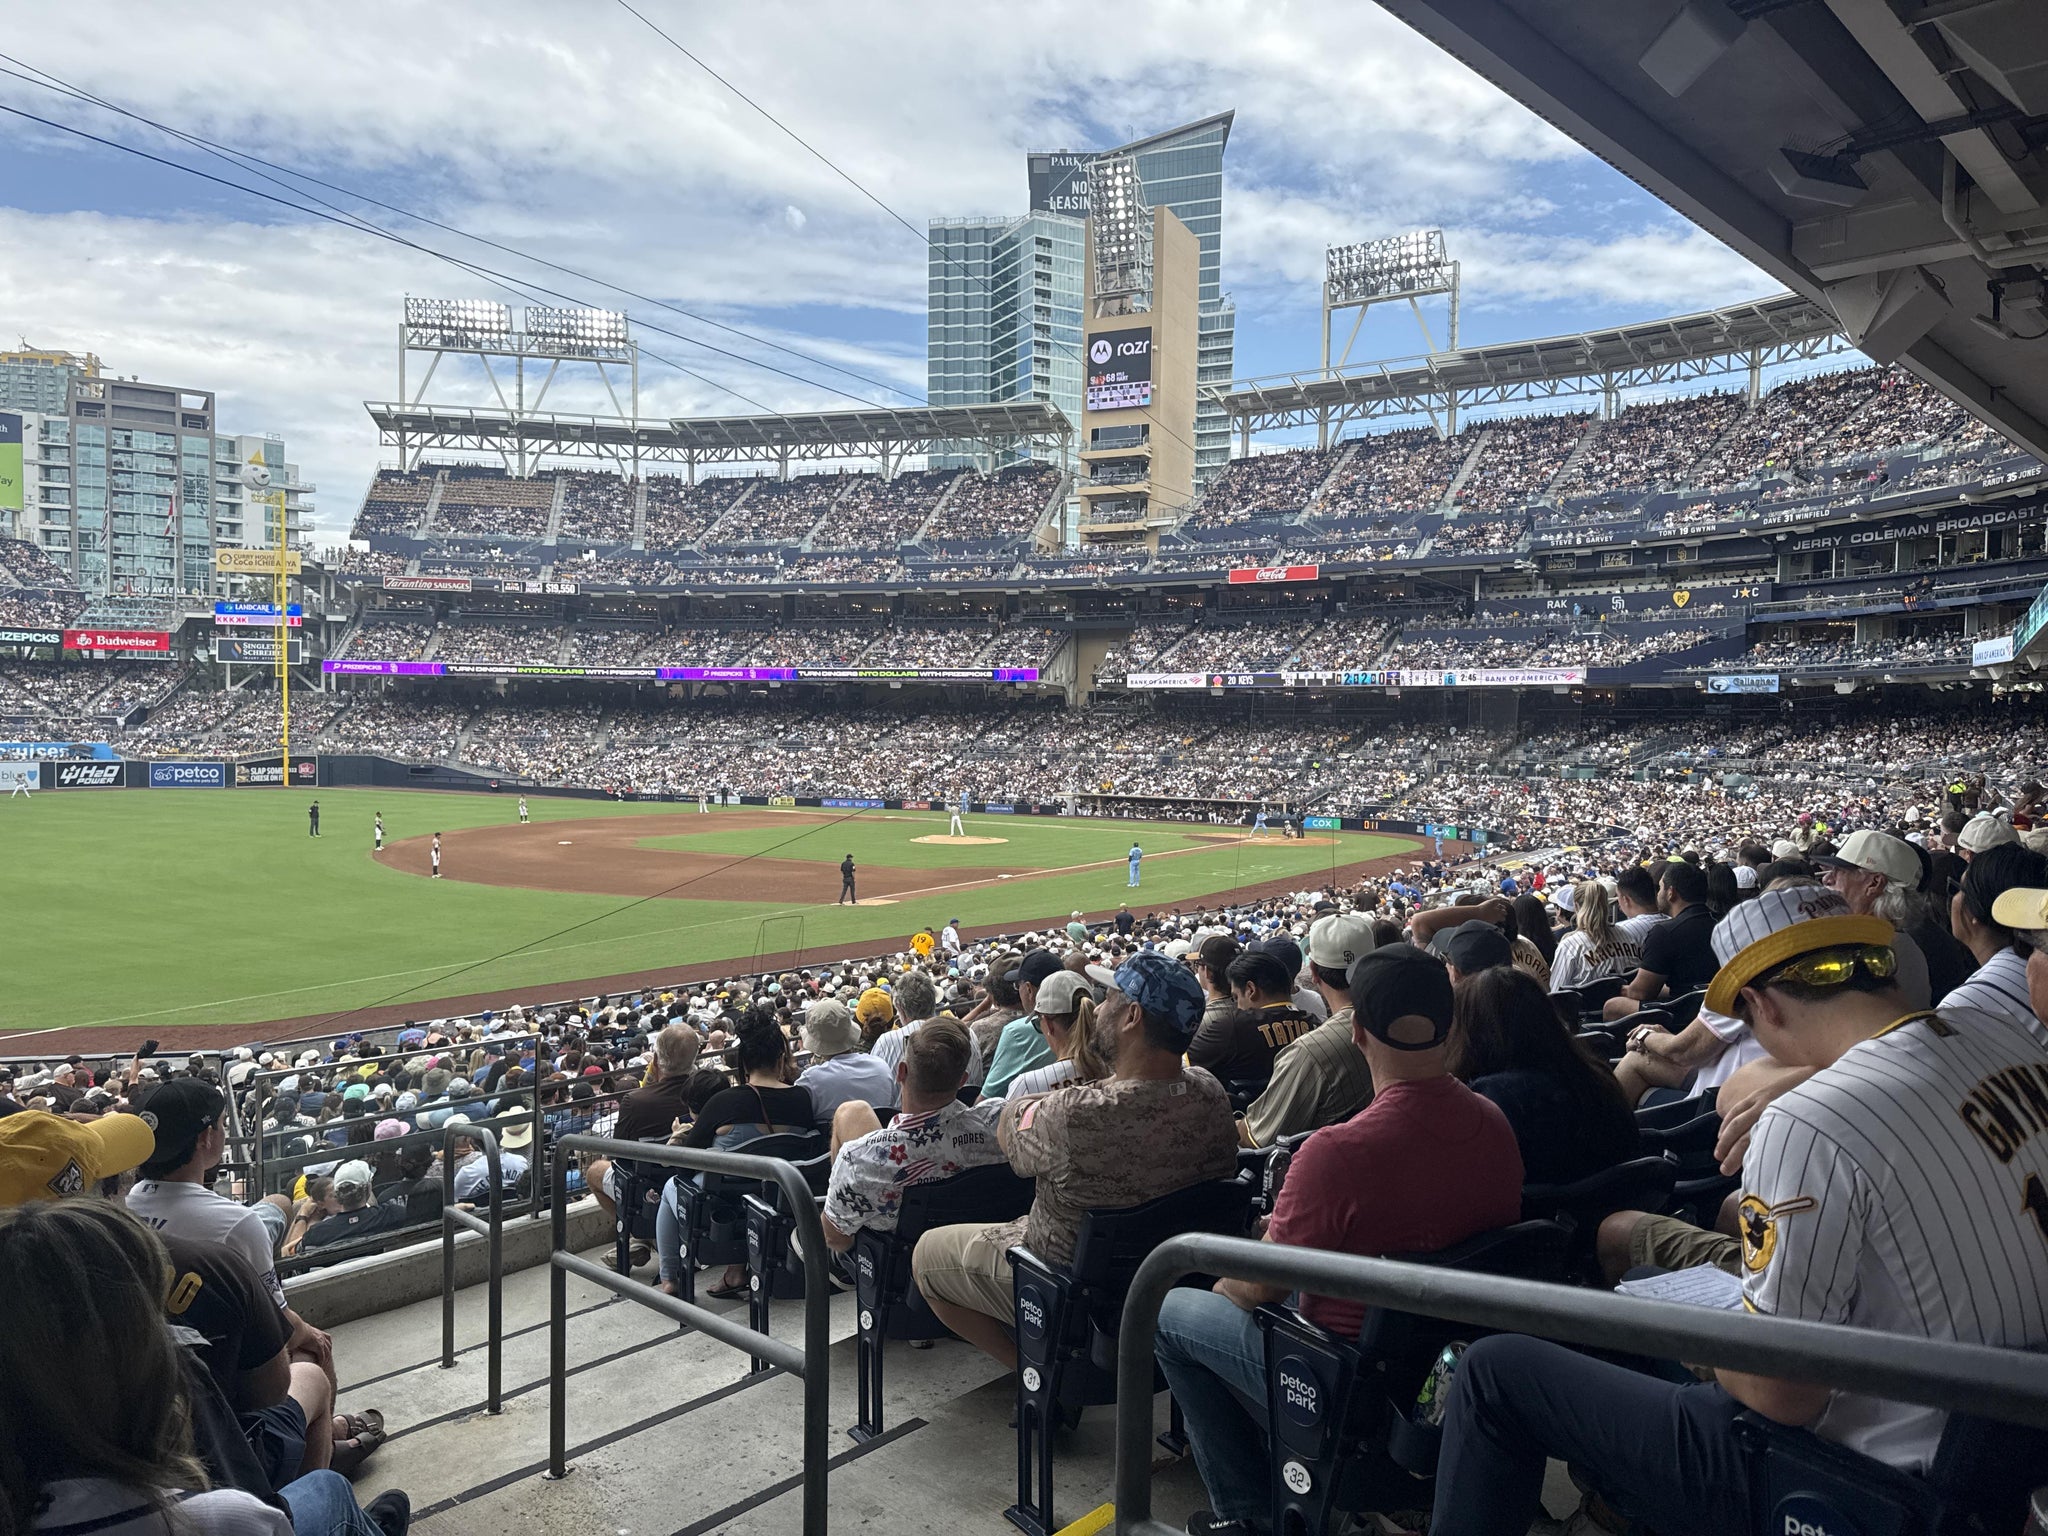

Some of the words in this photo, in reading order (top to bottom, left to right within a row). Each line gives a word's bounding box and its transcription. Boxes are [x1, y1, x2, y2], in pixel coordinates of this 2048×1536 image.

[1051, 156, 1080, 167] PARK
[1071, 180, 1088, 195] NO
[1049, 196, 1090, 210] LEASIN
[1117, 340, 1150, 356] razr
[1106, 373, 1115, 382] 68
[0, 475, 13, 486] ay
[1982, 475, 2005, 488] RANDY
[2006, 471, 2018, 483] 35
[2018, 467, 2042, 480] JONES
[1763, 516, 1782, 525] DAVE
[1784, 514, 1793, 523] 31
[1795, 510, 1830, 521] WINFIELD
[1659, 529, 1676, 537] TONY
[1679, 527, 1689, 536] 19
[1691, 525, 1716, 534] GWYNN
[1793, 535, 1844, 551] JERRY
[1850, 523, 1930, 545] COLEMAN
[1936, 505, 2038, 533] BROADCAST
[1585, 535, 1613, 544] GARVEY
[386, 578, 432, 589] Tarantino
[434, 581, 470, 590] SAUSAGES
[545, 583, 576, 594] $19,550
[1732, 588, 1739, 599] J
[1751, 587, 1760, 597] C
[1547, 599, 1568, 609] RAK
[0, 632, 60, 643] IZEPICKS
[96, 635, 157, 647] Budweiser
[243, 642, 282, 650] SINGLETO
[1989, 648, 2006, 659] AMERICA
[448, 665, 475, 673] TURN
[475, 666, 517, 674] DINGERS
[1227, 676, 1236, 685] 20
[1238, 676, 1254, 685] KEYS
[1344, 673, 1350, 685] 2
[1362, 673, 1367, 684] 2
[1460, 673, 1477, 682] 2:45
[1521, 674, 1559, 682] AMERICA
[1733, 677, 1776, 687] Gallagher
[80, 765, 120, 778] H2O
[174, 767, 219, 780] petco
[250, 767, 266, 775] SLAP
[267, 767, 284, 775] SOME
[77, 777, 115, 785] POWER
[1312, 819, 1332, 827] COX
[917, 935, 926, 943] 19
[866, 1132, 898, 1147] PADRES
[952, 1132, 985, 1148] PADRES
[858, 1254, 873, 1270] petco
[860, 1265, 873, 1278] park
[1021, 1297, 1043, 1318] petco
[862, 1314, 870, 1327] 30
[1024, 1310, 1043, 1329] park
[1027, 1372, 1036, 1387] 31
[1280, 1371, 1316, 1399] petco
[1287, 1388, 1316, 1414] park
[1289, 1467, 1304, 1488] 32
[1784, 1515, 1834, 1536] pet
